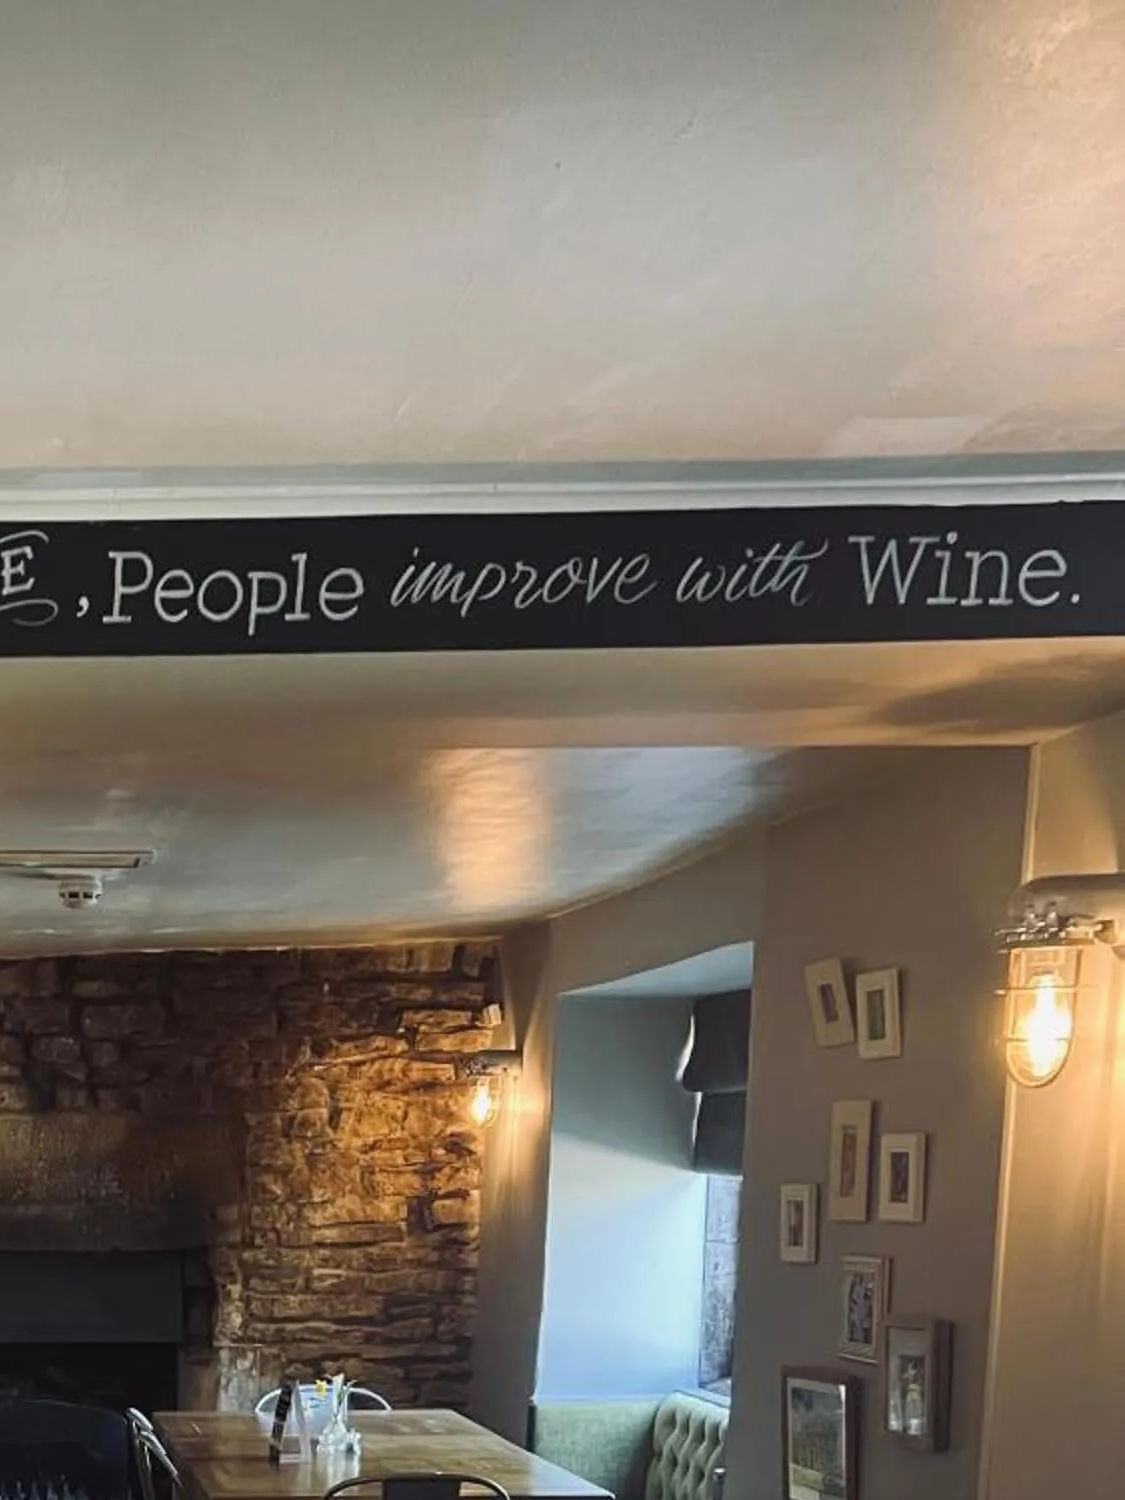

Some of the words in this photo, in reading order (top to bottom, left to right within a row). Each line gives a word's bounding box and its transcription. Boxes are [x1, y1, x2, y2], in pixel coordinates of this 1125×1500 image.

[388, 545, 658, 617] improve
[676, 540, 828, 605] with
[848, 530, 1080, 607] Wine.
